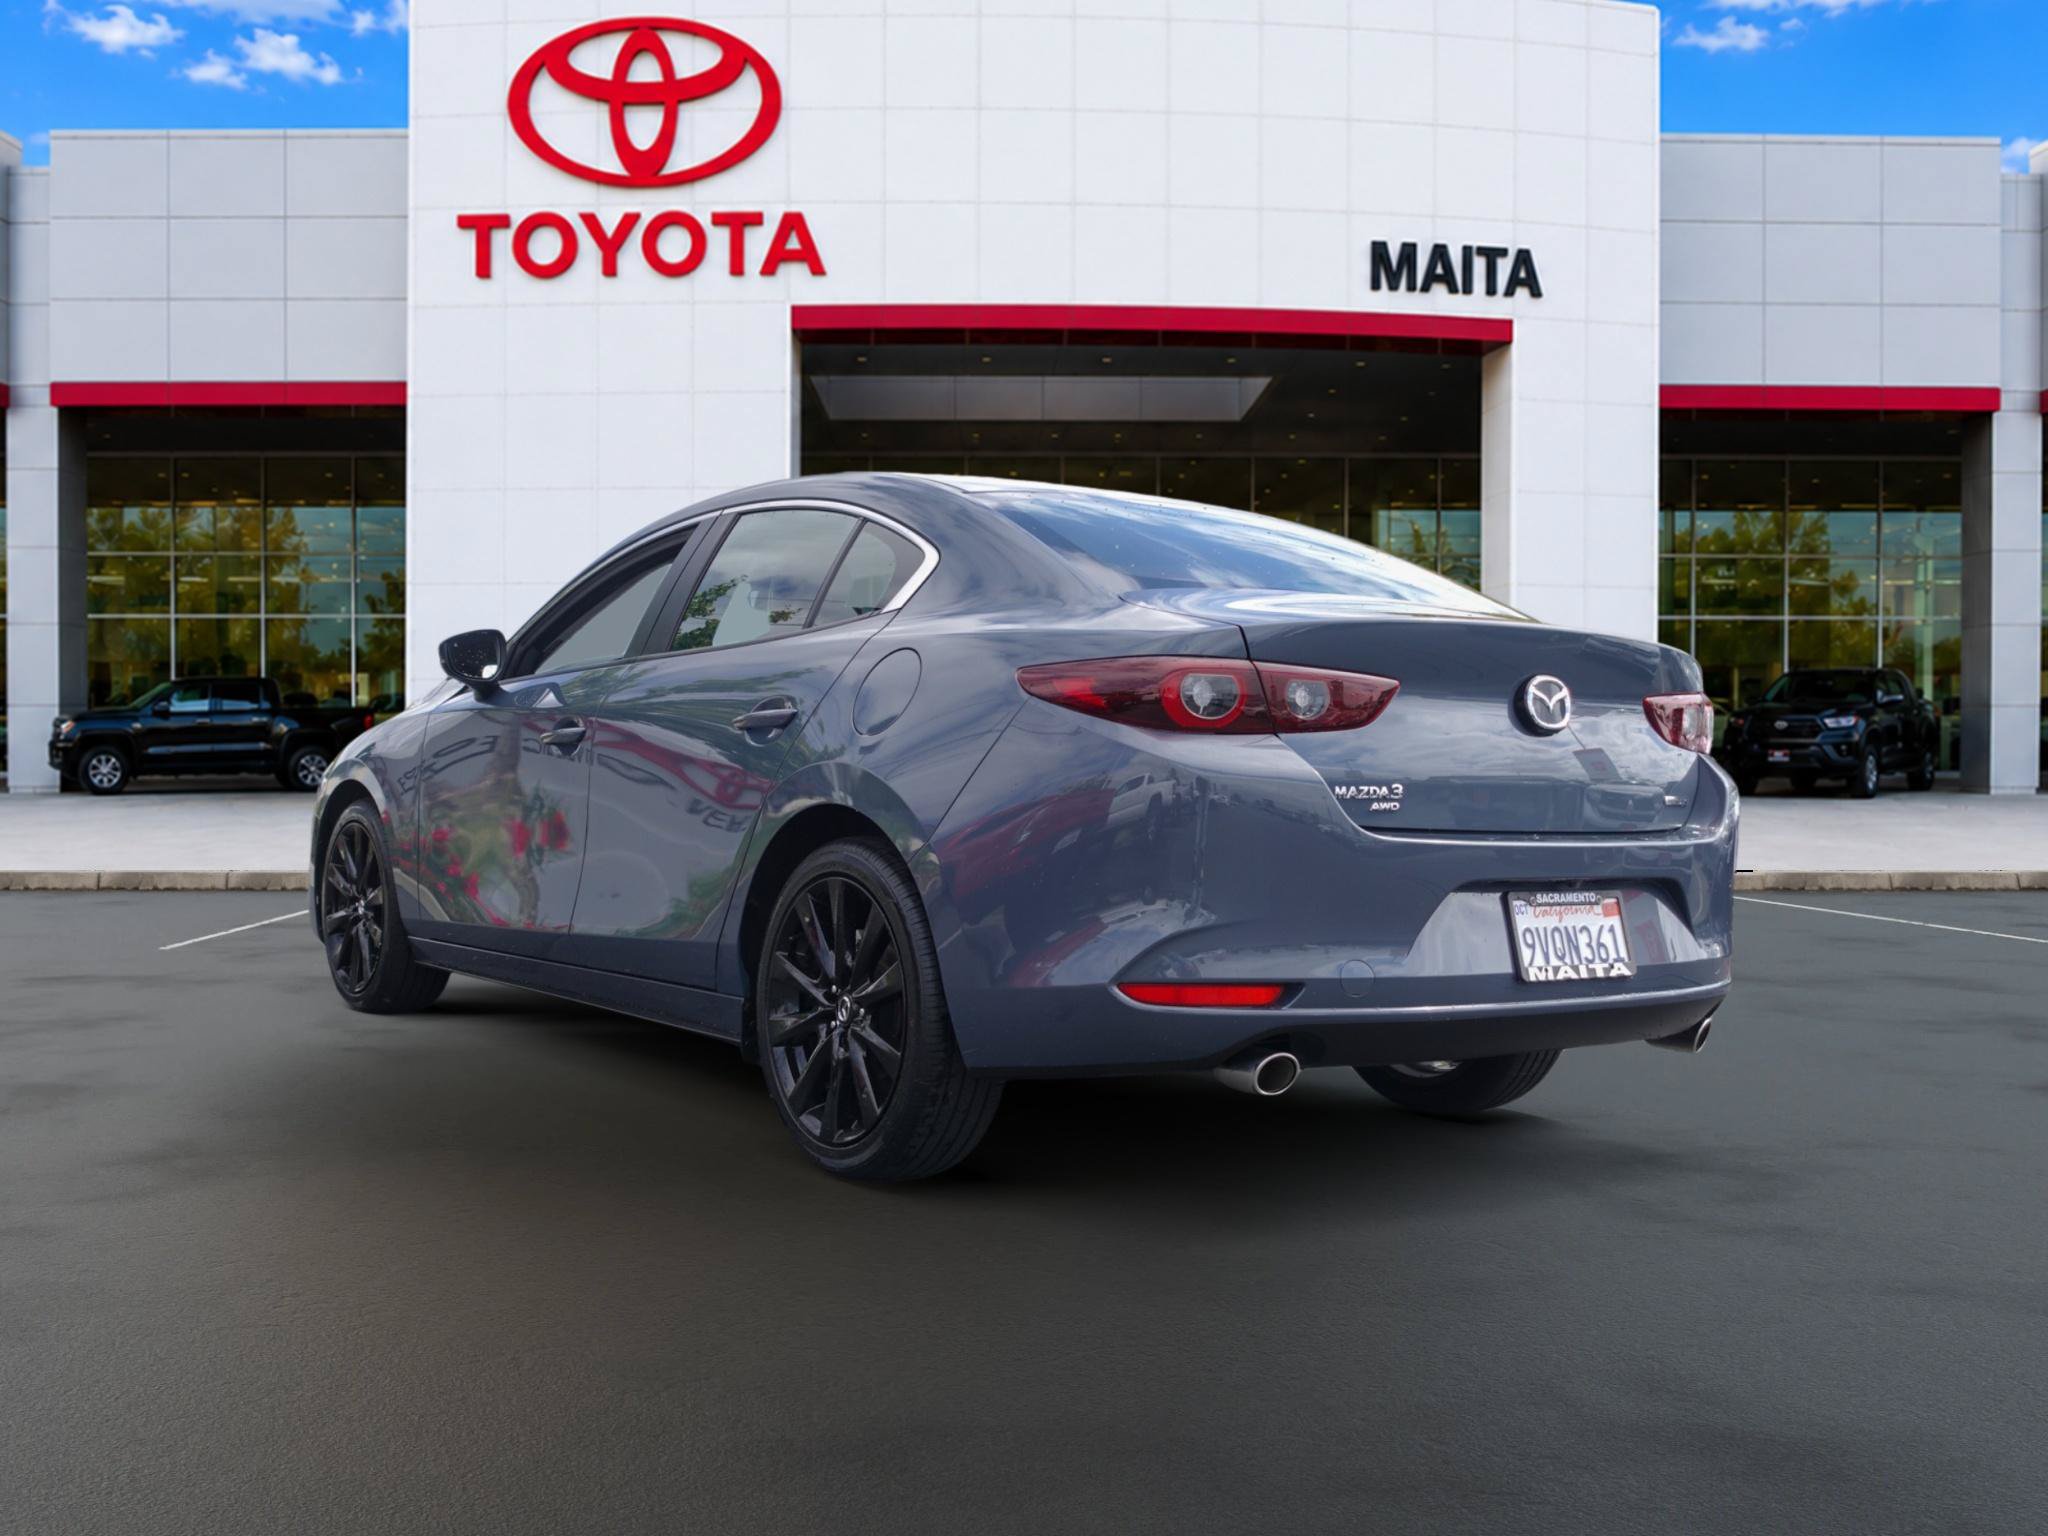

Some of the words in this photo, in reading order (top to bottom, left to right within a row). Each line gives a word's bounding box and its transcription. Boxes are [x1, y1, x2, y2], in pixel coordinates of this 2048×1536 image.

[457, 210, 827, 280] TOYOTA
[1370, 240, 1543, 299] MAITA
[1369, 801, 1401, 812] AWD
[1536, 892, 1596, 904] SACRAMENTO
[1532, 904, 1600, 922] California
[1522, 924, 1626, 966] 9VQN361
[1527, 962, 1632, 982] MAITA
